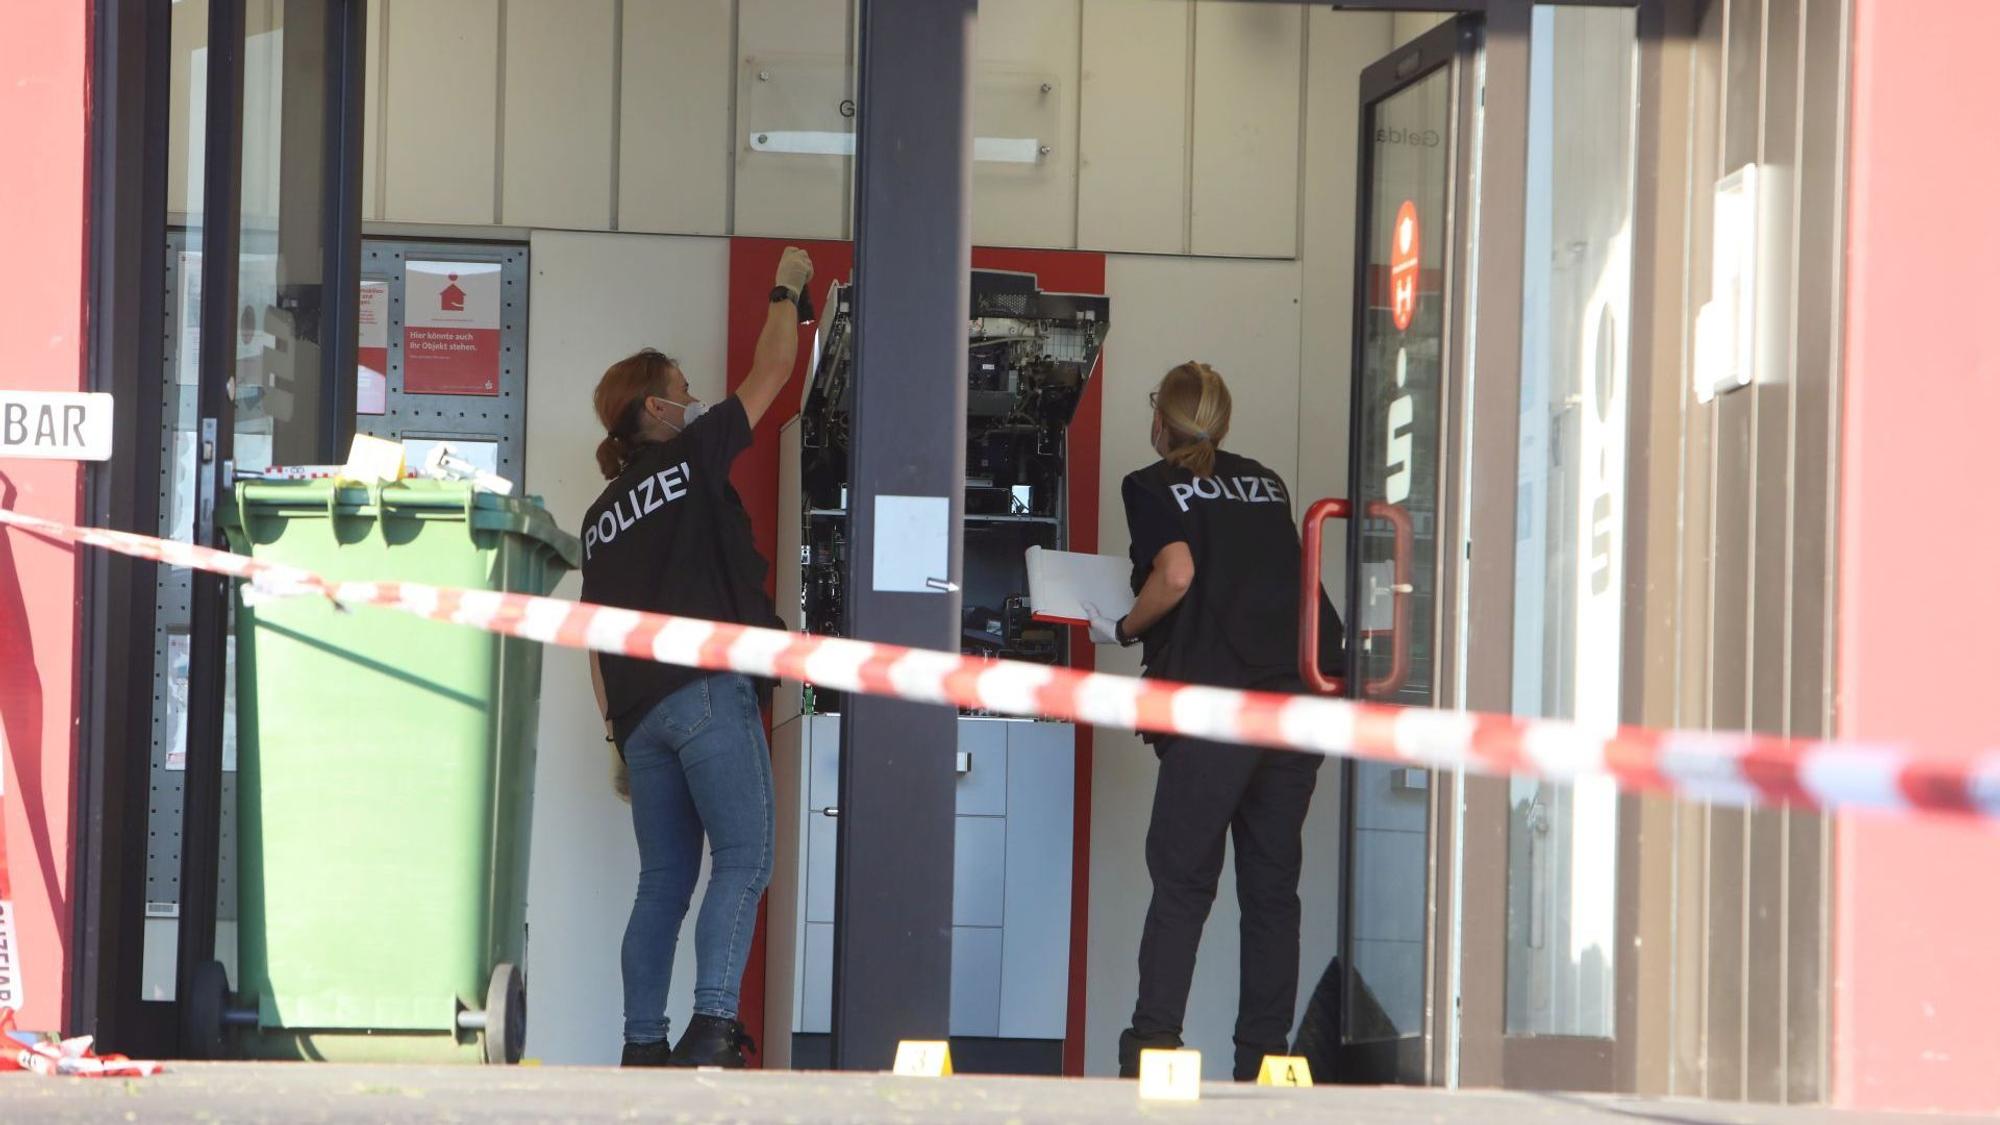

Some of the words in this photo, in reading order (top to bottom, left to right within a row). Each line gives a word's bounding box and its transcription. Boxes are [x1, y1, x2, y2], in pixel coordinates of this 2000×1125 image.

[409, 331, 426, 340] Hier
[427, 331, 454, 341] könnte
[455, 332, 474, 342] auch
[409, 341, 421, 350] Ihr
[421, 341, 448, 352] Objekt
[448, 342, 477, 352] stehen.
[4, 402, 86, 447] BAR
[1168, 475, 1287, 512] POLIZE
[1286, 1064, 1298, 1087] 4
